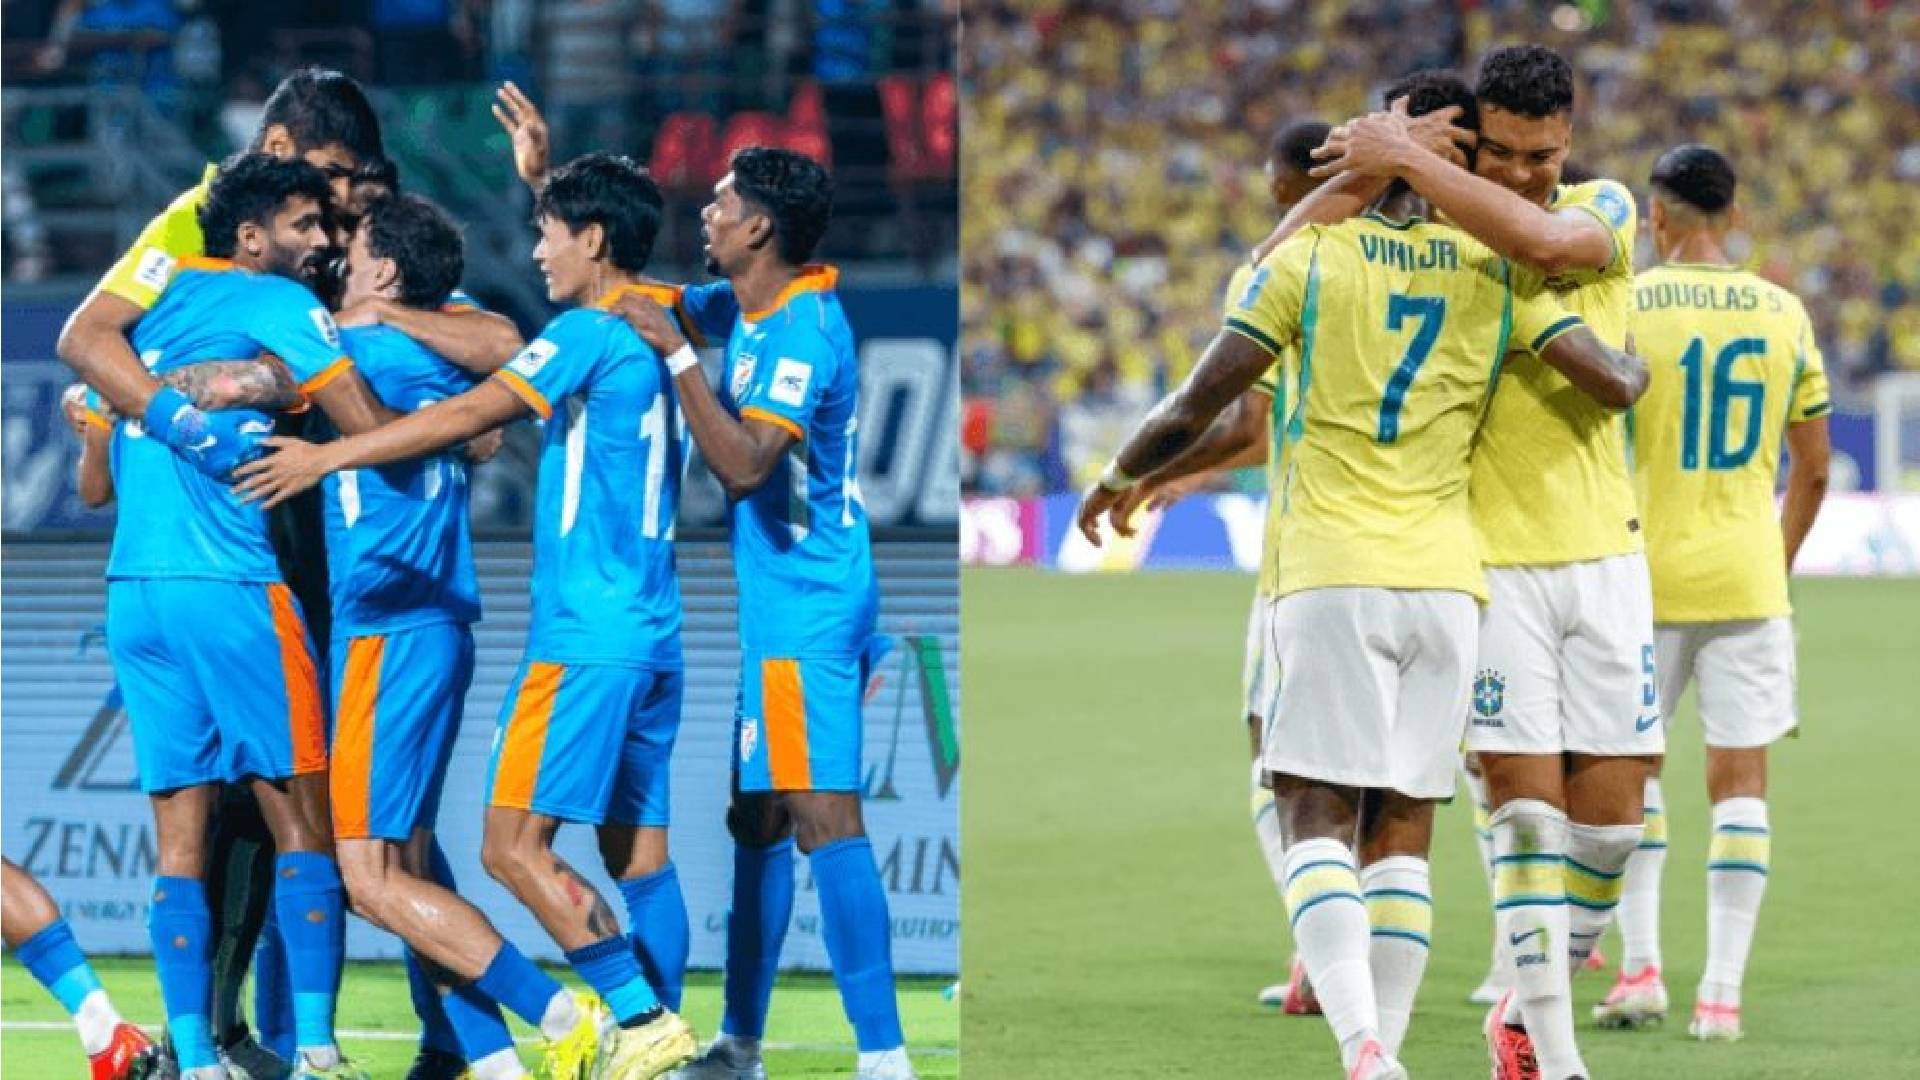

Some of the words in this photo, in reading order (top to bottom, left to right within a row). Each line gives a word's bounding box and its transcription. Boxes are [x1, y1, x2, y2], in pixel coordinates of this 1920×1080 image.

[1359, 234, 1415, 272] VINI
[1636, 282, 1759, 312] DOUGLAS
[1378, 293, 1446, 444] 7
[1679, 336, 1766, 470] 16
